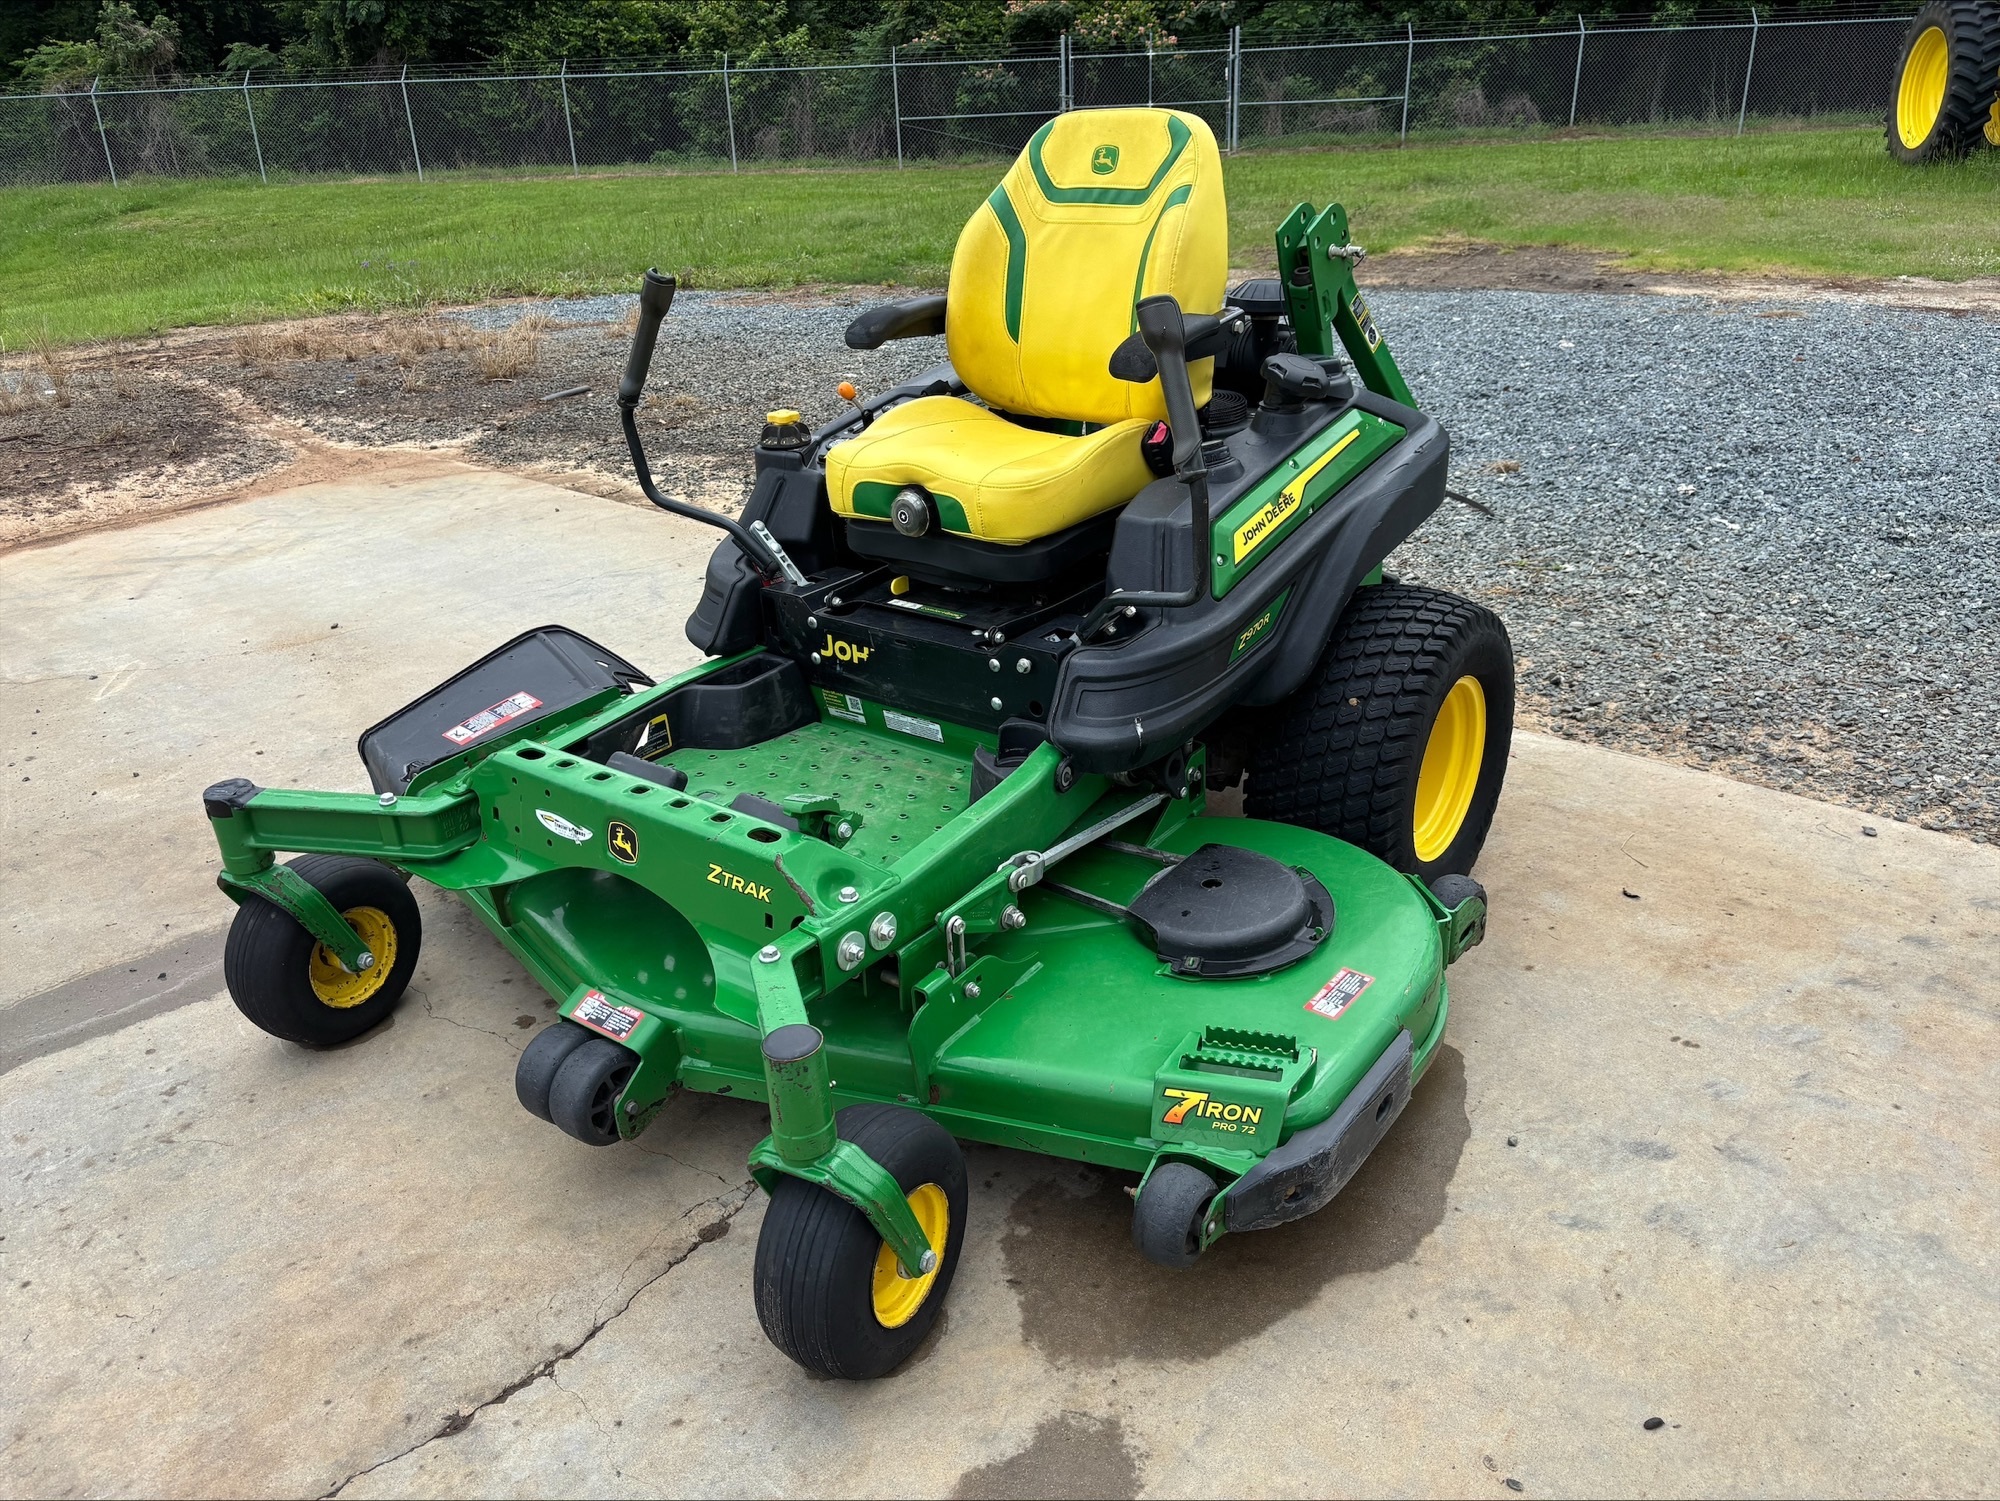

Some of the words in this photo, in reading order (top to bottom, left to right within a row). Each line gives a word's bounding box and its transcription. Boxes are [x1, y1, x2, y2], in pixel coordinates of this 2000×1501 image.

[1242, 518, 1267, 546] JOHN
[1264, 492, 1296, 524] DEERE
[820, 633, 875, 664] JOH
[1237, 612, 1271, 650] Z970R
[706, 862, 773, 904] ZTRAK
[1211, 1121, 1238, 1132] PRO
[1241, 1125, 1256, 1135] 72
